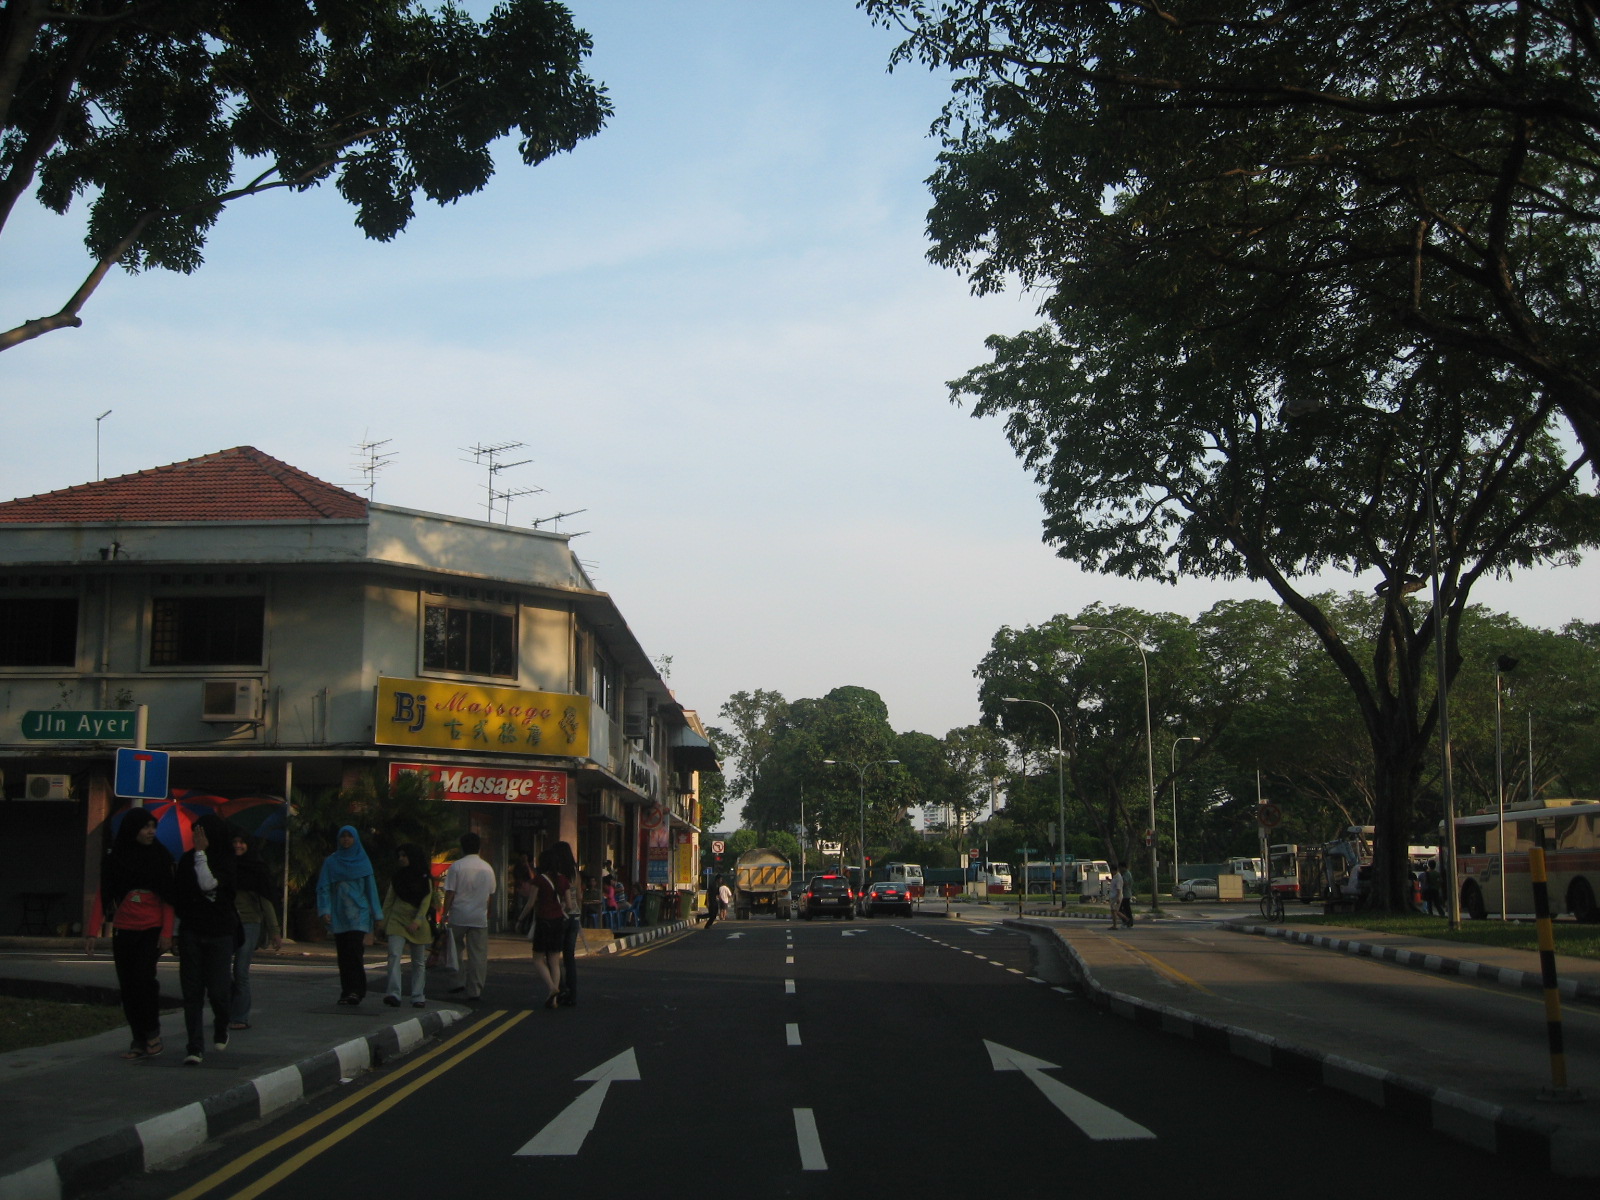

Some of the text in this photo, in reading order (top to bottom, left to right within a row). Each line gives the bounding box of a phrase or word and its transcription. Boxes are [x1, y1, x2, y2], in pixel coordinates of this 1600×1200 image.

[34, 714, 129, 737] Jln Ayer
[392, 691, 553, 732] Bj Massage
[439, 770, 534, 801] Massage
